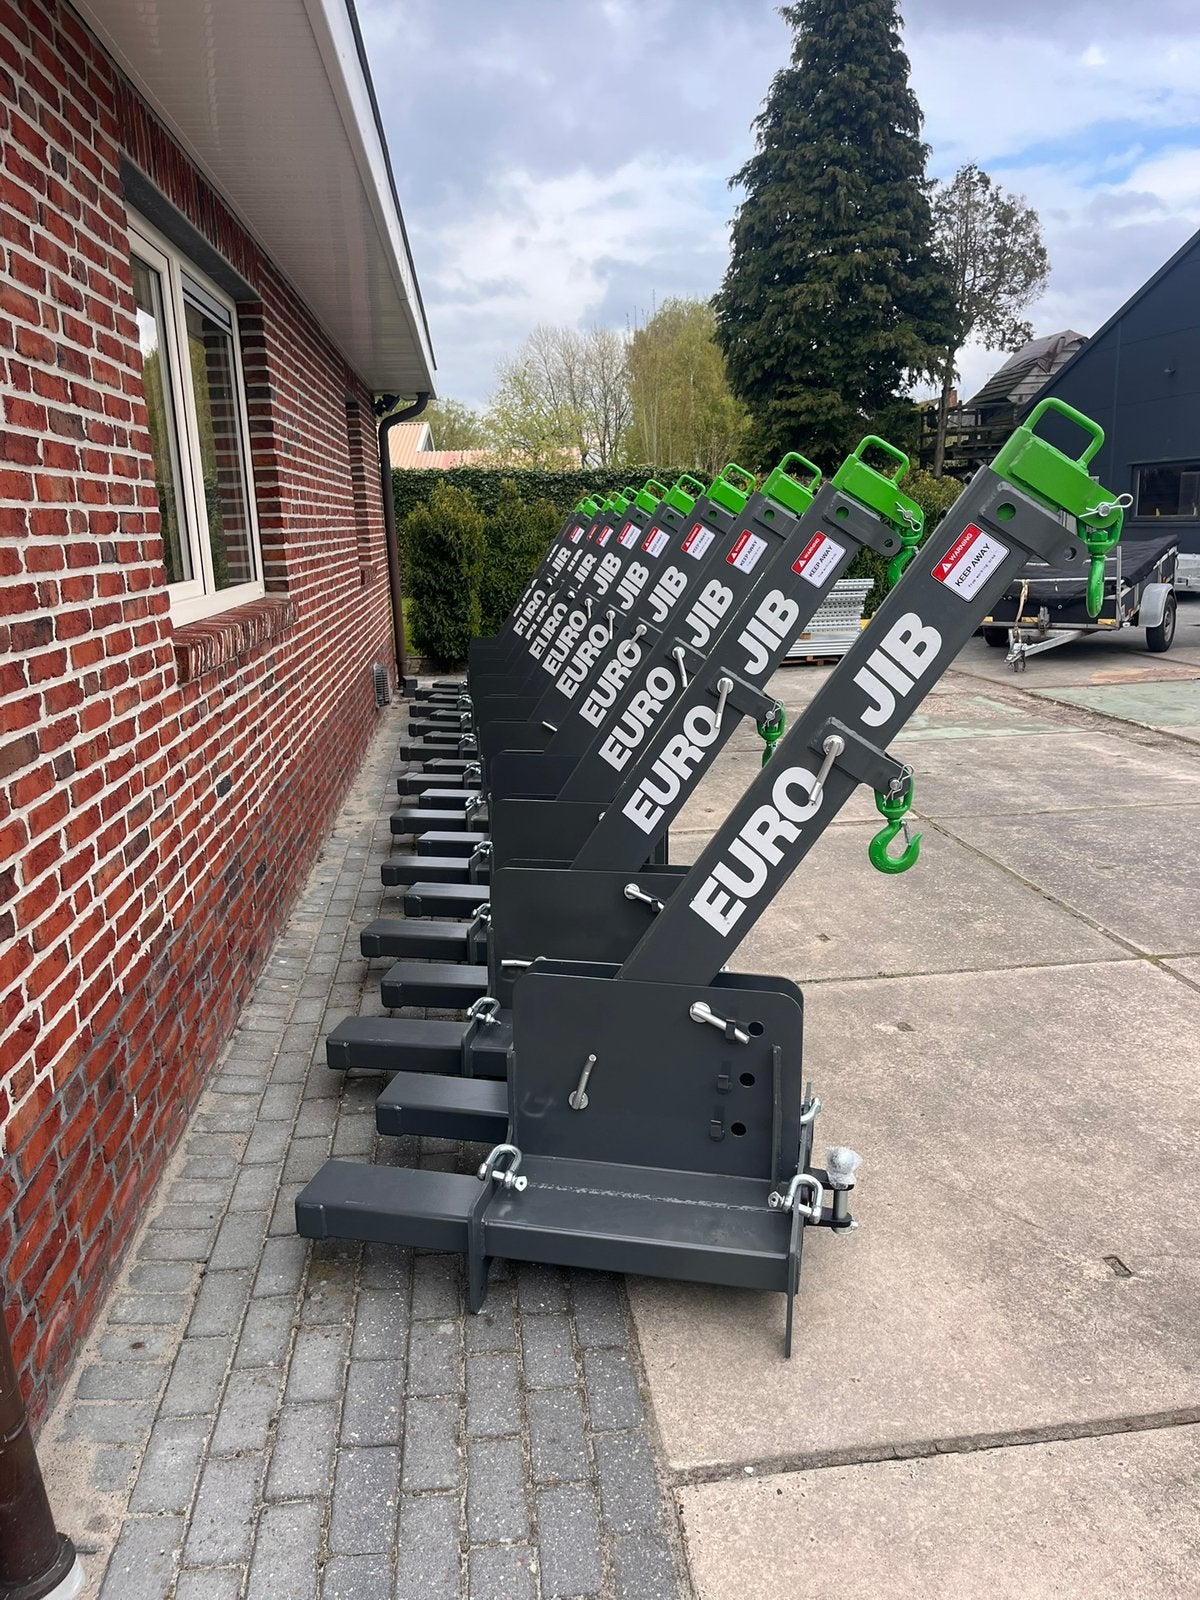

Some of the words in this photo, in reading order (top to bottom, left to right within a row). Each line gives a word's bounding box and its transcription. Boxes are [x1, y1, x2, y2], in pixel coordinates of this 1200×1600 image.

[808, 561, 820, 578] KEEP
[819, 545, 833, 563] AWAY
[949, 532, 973, 561] WARNING
[954, 565, 972, 587] KEEP
[971, 543, 991, 568] AWAY
[528, 602, 568, 660] EURO
[541, 610, 588, 677] EURO
[593, 552, 622, 595] JIB
[555, 624, 610, 700] EURO
[616, 561, 650, 610] JIB
[578, 639, 642, 728] EURO
[647, 565, 688, 623] JIB
[598, 666, 676, 772] EURO
[684, 579, 734, 648] JIB
[622, 705, 720, 835] EURO
[737, 589, 800, 675] JIB
[689, 766, 824, 937] EURO
[853, 613, 943, 727] JIB
